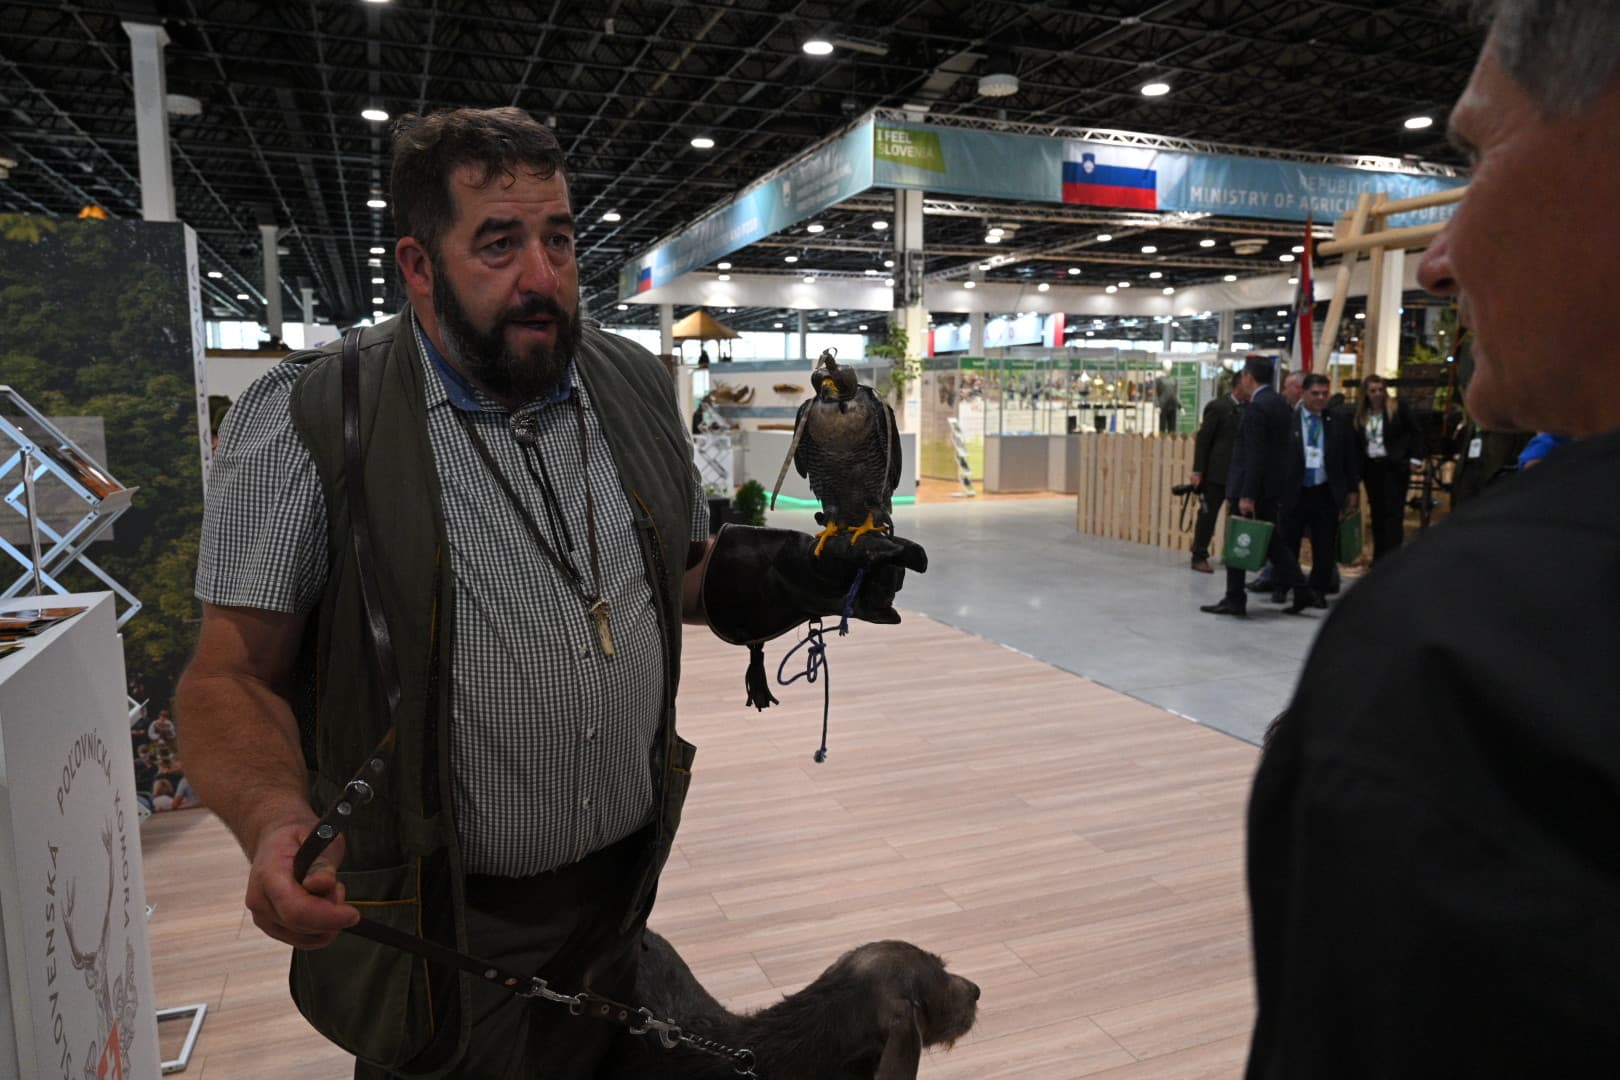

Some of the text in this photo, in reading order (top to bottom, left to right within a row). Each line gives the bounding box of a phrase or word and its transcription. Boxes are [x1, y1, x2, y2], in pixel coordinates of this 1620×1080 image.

[877, 129, 912, 144] I FEEL
[878, 143, 933, 158] SLOVENIA
[1190, 186, 1268, 206] MINISTRY
[1273, 192, 1294, 209] OF
[114, 788, 130, 928] KOMORA
